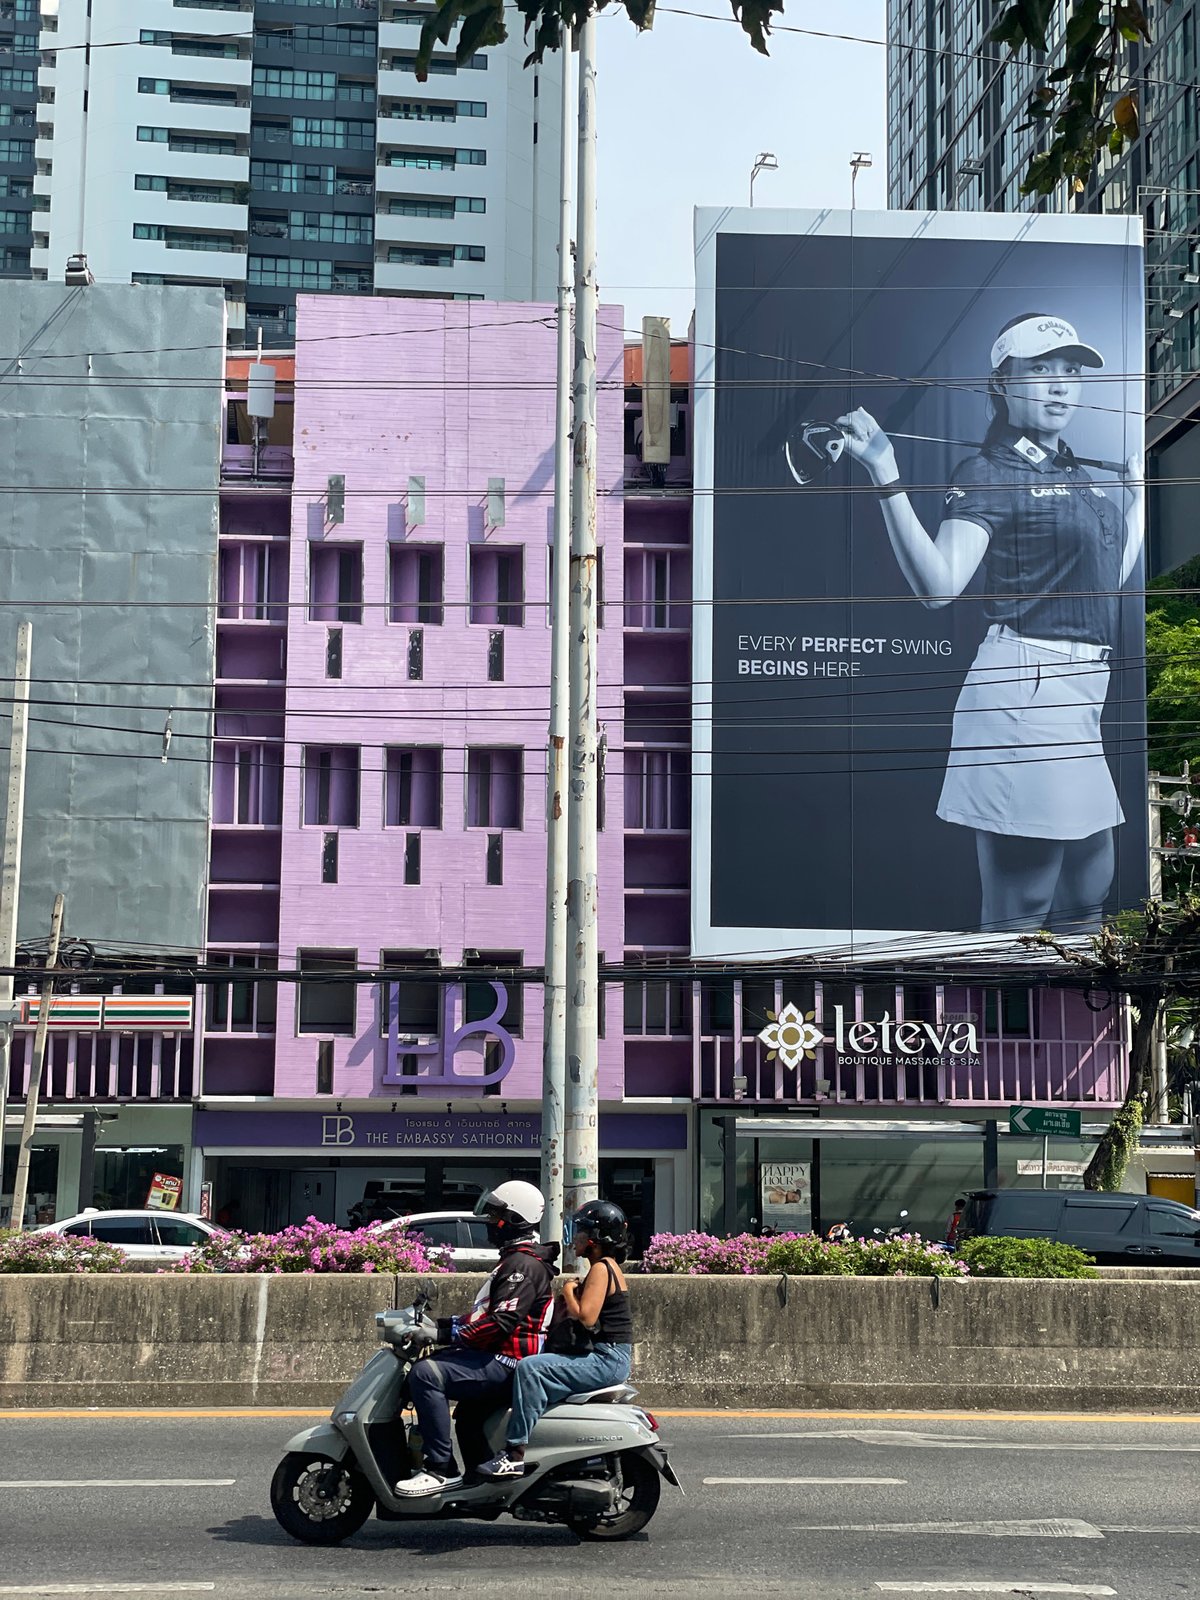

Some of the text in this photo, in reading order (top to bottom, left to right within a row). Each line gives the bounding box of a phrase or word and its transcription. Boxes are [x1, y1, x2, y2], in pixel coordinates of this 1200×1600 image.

[738, 635, 953, 656] EVERY PERFECT SWING
[738, 659, 809, 676] BEGINS
[833, 1004, 982, 1055] leteva
[838, 1056, 981, 1066] BOUTIQUE MASSAGE & SPA
[366, 1132, 389, 1144] THE
[396, 1132, 455, 1144] EMBASSY
[462, 1132, 523, 1144] SATHORN
[764, 1166, 807, 1176] HAPPY
[764, 1177, 794, 1185] HOUR
